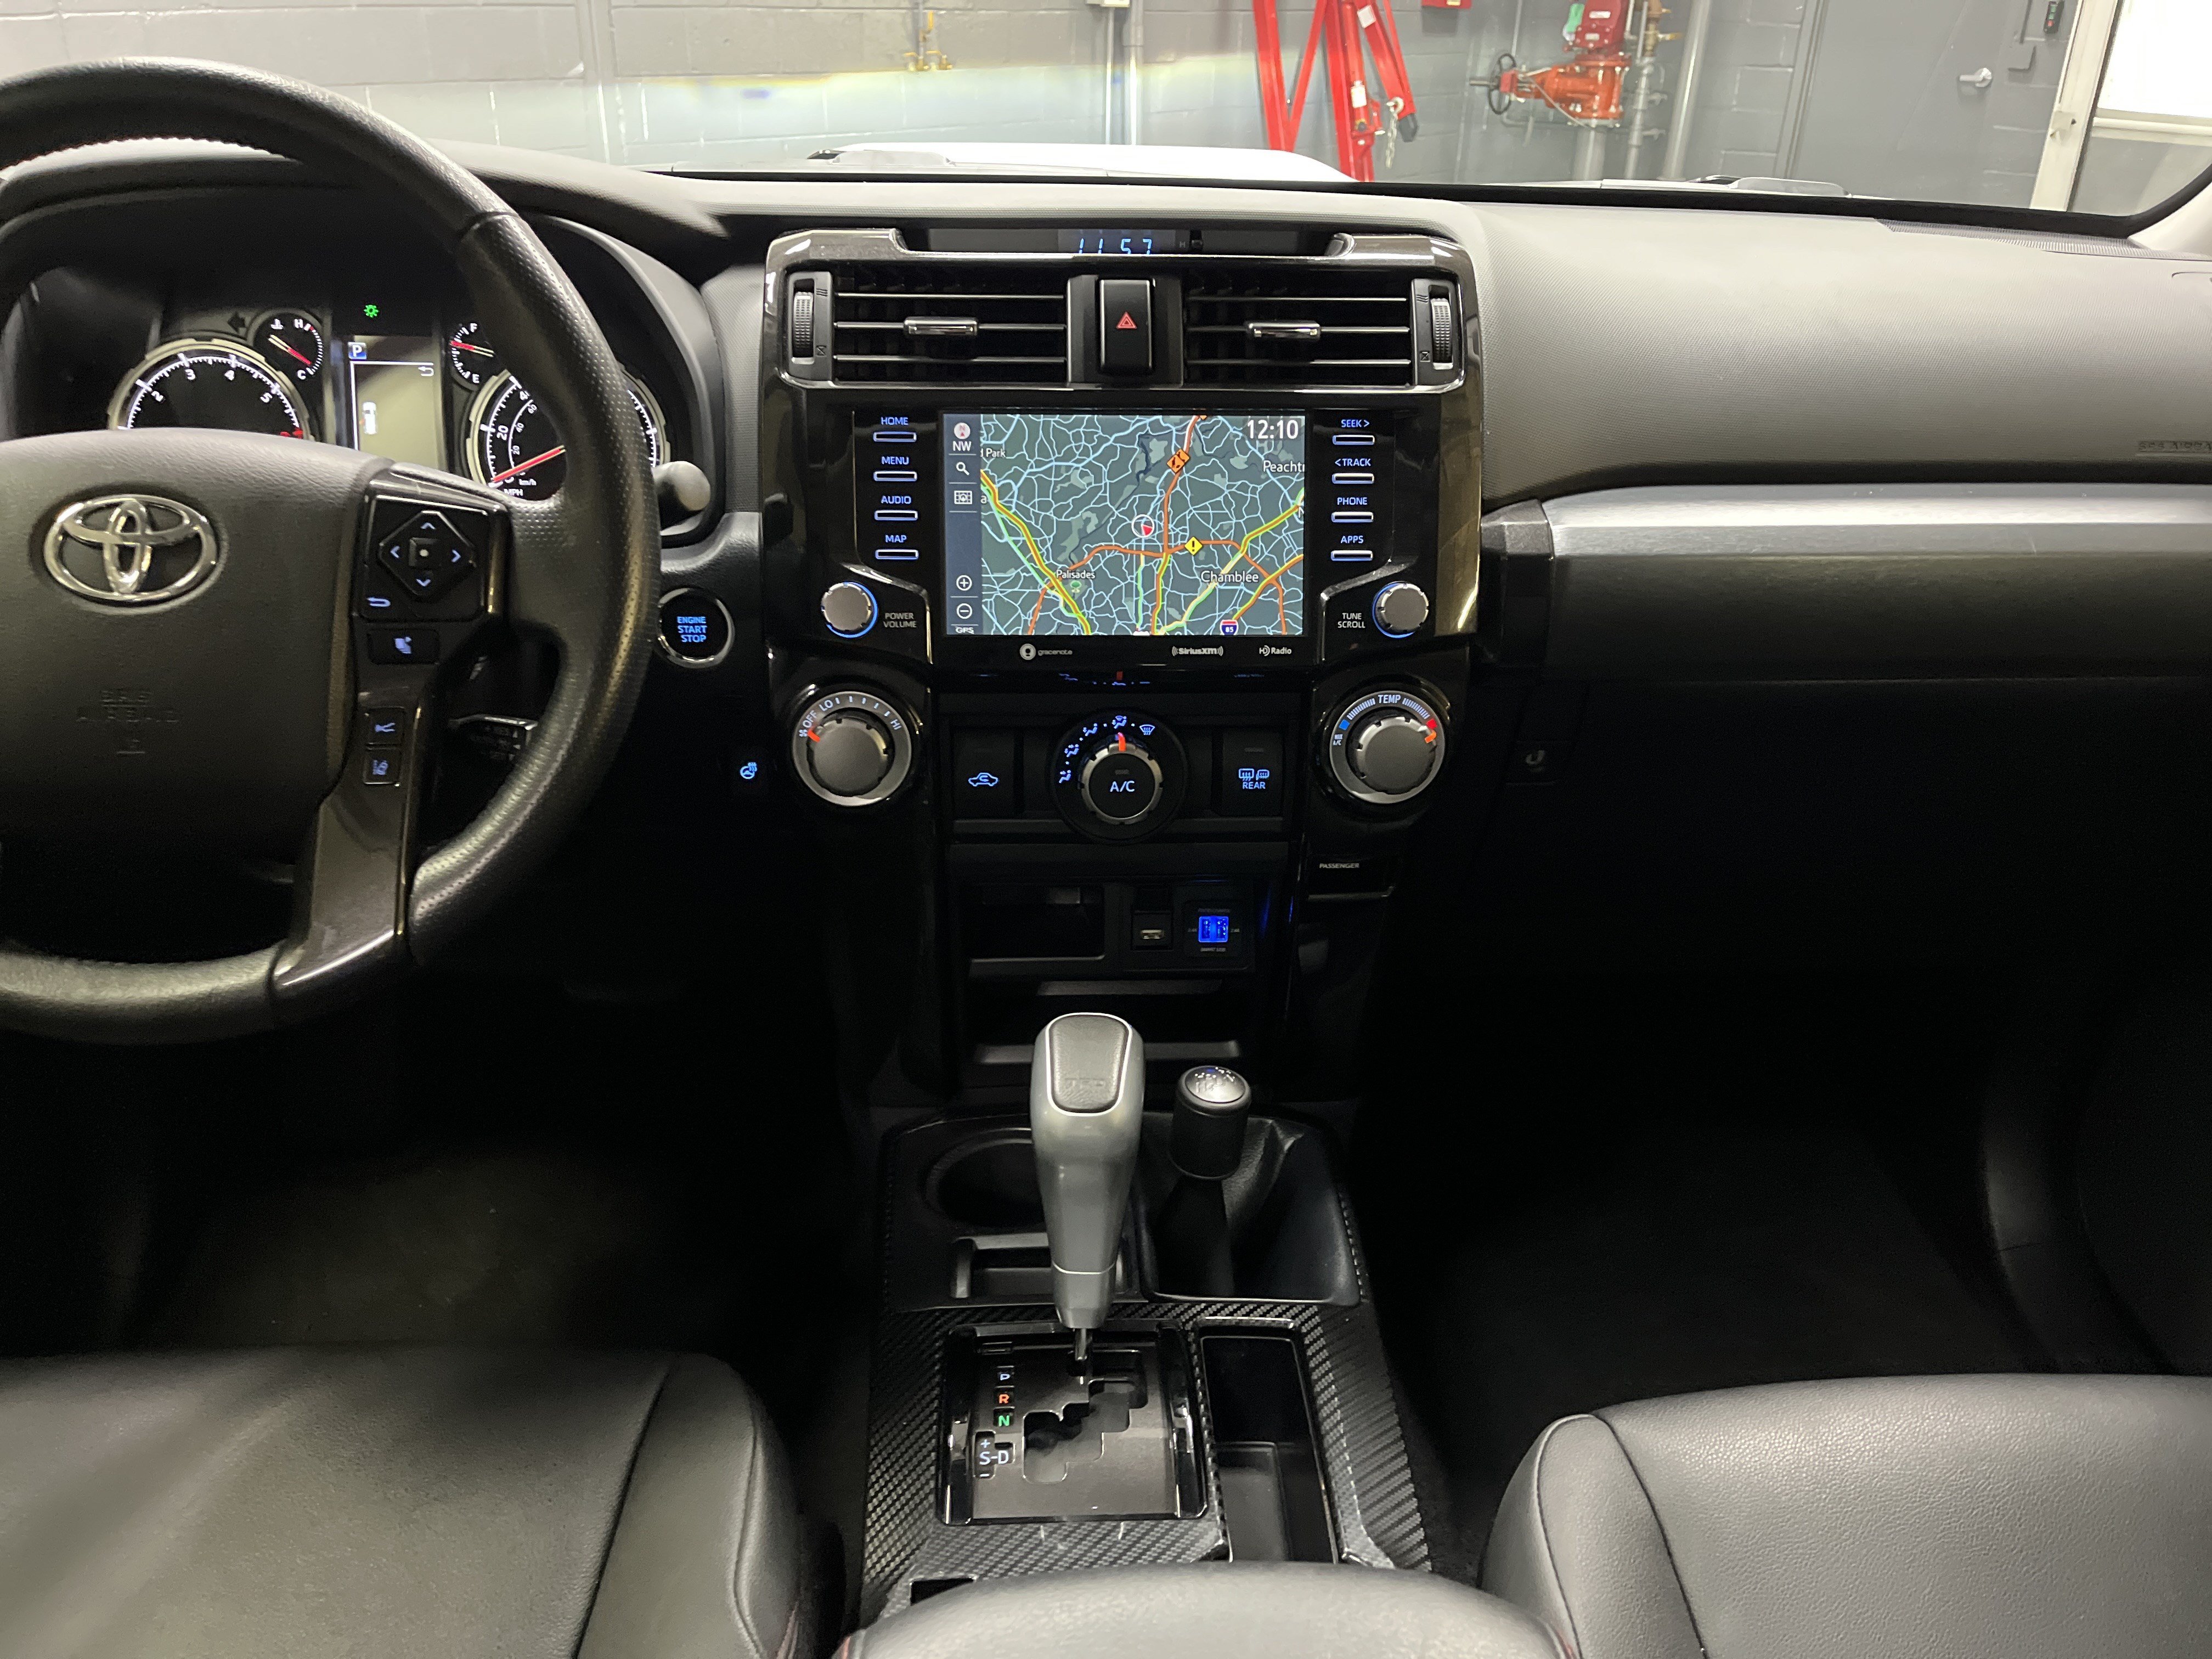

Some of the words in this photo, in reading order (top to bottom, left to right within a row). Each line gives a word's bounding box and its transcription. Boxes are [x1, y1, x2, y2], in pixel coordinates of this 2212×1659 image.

[294, 319, 303, 329] H
[470, 322, 478, 332] F
[352, 345, 362, 356] P
[186, 369, 195, 380] 3
[225, 370, 235, 380] 4
[297, 369, 306, 380] C
[472, 374, 479, 383] E
[152, 391, 164, 402] 2
[260, 393, 273, 403] 5
[881, 417, 909, 426] HOME
[496, 425, 509, 441] 20
[1247, 420, 1299, 439] 12:10
[512, 445, 520, 455] 20
[952, 441, 972, 452] NW
[986, 448, 1006, 458] Park
[881, 456, 909, 465] MENU
[503, 488, 523, 496] MPH
[881, 495, 912, 505] AUDIO
[1337, 496, 1368, 506] PHONE
[885, 534, 907, 544] MAP
[1341, 535, 1364, 545] APPS
[1056, 569, 1095, 579] Palisades
[1200, 571, 1259, 583] Chamblee
[884, 612, 914, 620] POWER
[677, 625, 708, 634] START
[883, 620, 917, 629] VOLUME
[1338, 620, 1366, 629] SCROLL
[681, 634, 707, 642] STOP
[1378, 694, 1401, 704] TEMP
[819, 699, 833, 712] LO
[803, 710, 816, 728] OFF
[890, 719, 902, 730] HI
[1110, 780, 1135, 793] A/C
[1242, 781, 1266, 789] REAR
[998, 1394, 1009, 1404] R
[998, 1415, 1010, 1426] N
